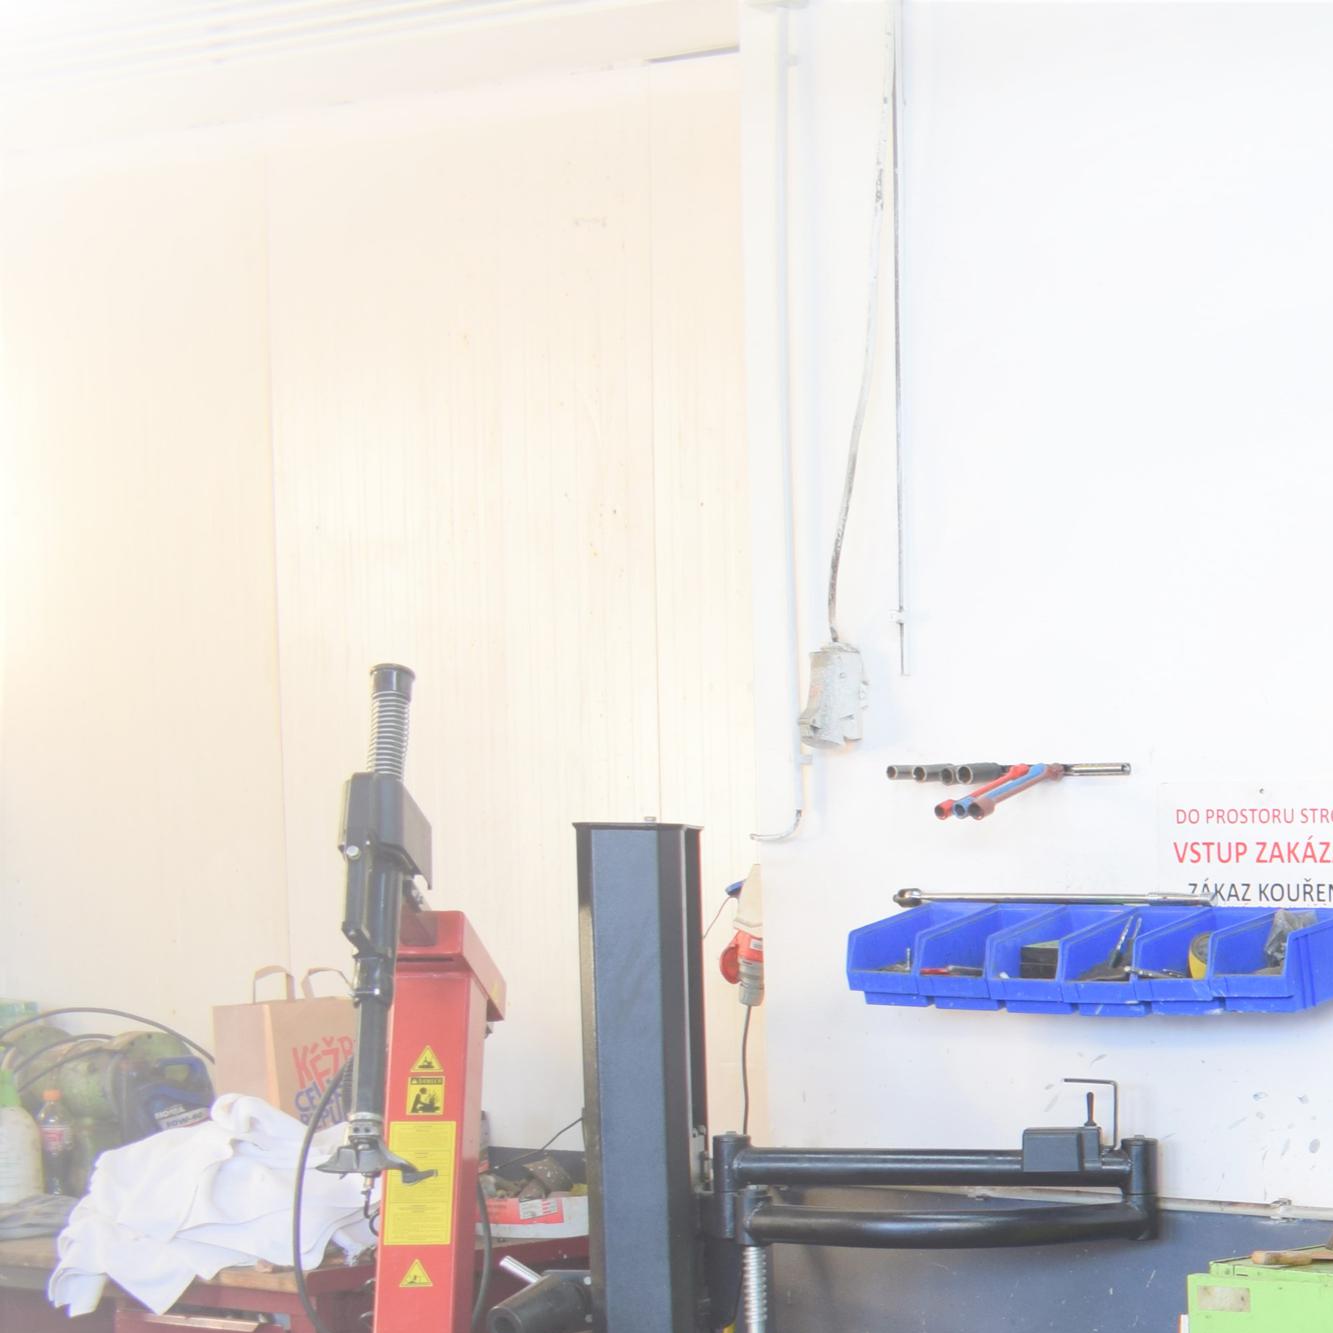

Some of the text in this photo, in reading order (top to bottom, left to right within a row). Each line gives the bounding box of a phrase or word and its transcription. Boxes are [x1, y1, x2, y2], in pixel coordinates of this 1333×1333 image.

[1176, 808, 1201, 825] DO
[1205, 807, 1295, 825] PROSTORU
[1173, 842, 1248, 864] VSTUP
